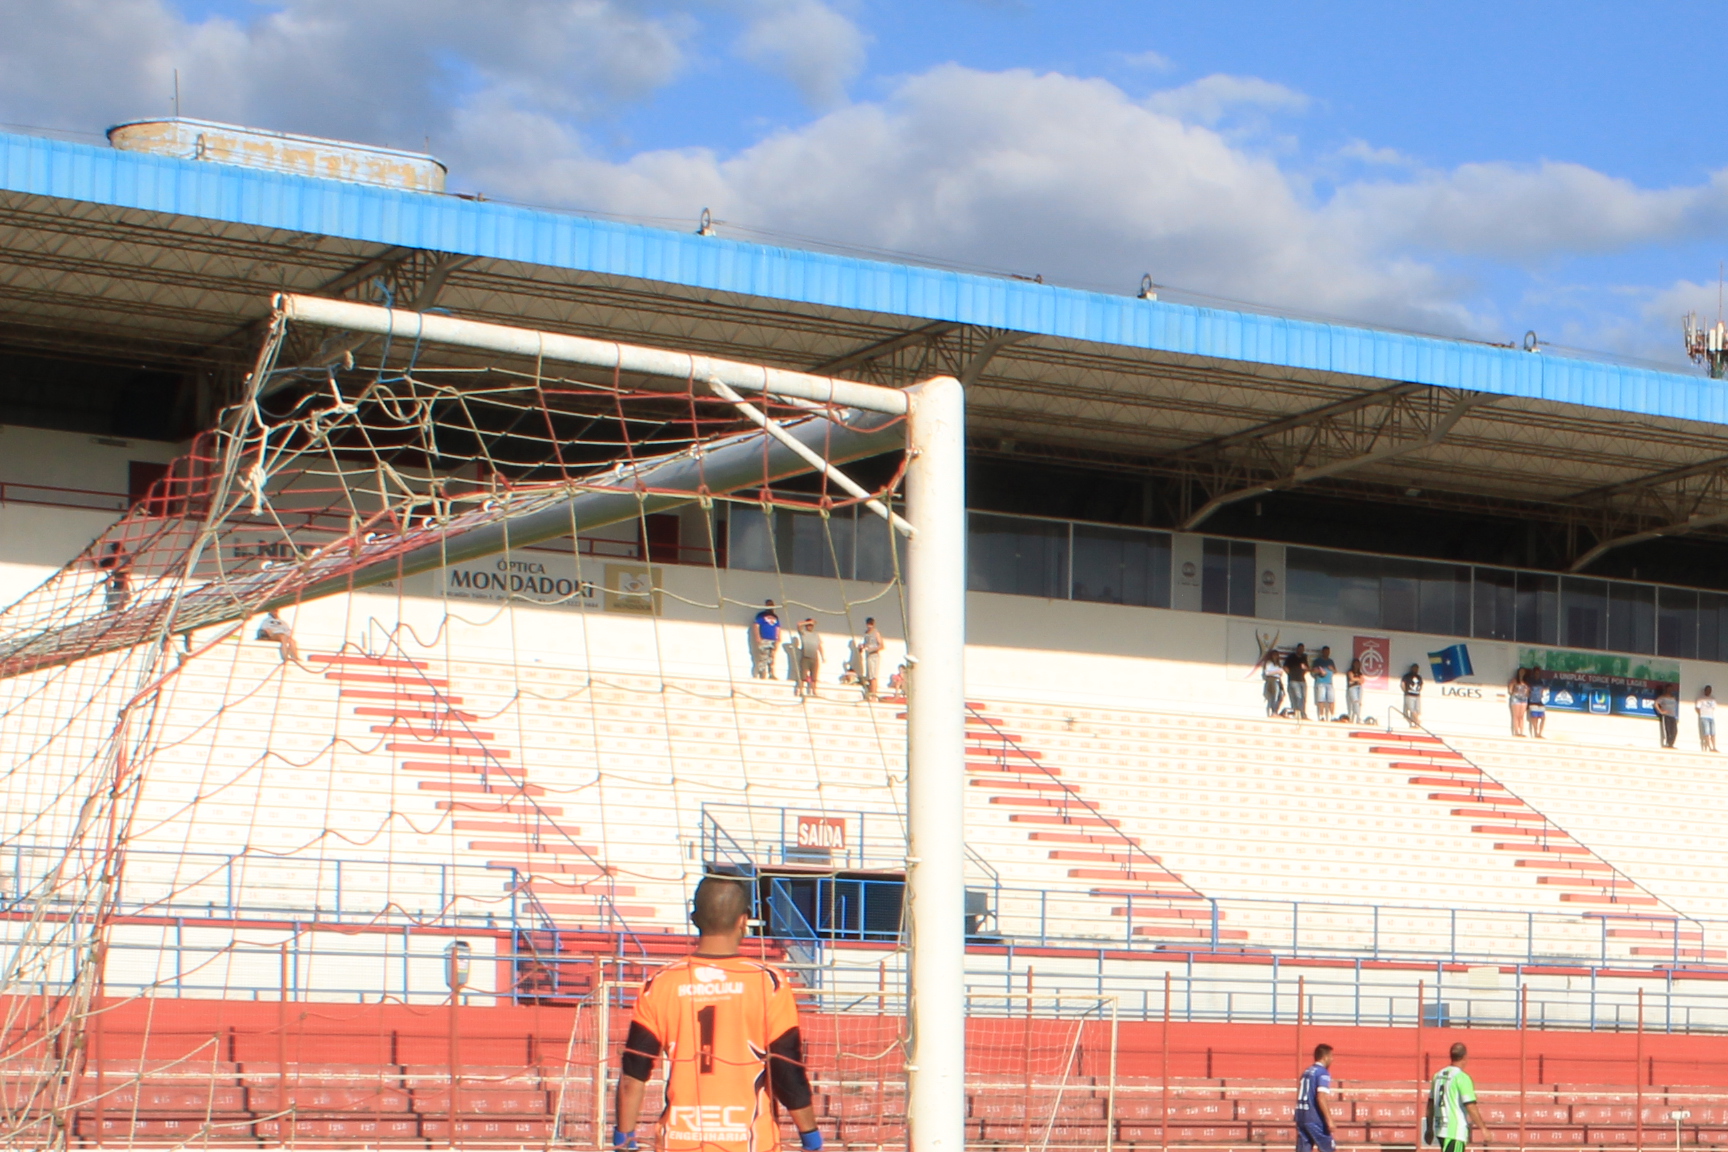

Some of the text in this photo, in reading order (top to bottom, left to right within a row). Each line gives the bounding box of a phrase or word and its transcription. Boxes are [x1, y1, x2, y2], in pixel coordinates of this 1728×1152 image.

[497, 557, 545, 574] ÓPTICA
[451, 570, 594, 598] MONDADORI
[1560, 674, 1586, 682] UNIPLAC
[1589, 676, 1609, 684] TORCE
[1627, 680, 1647, 688] LAGES
[1442, 686, 1482, 699] LAGES
[799, 818, 844, 848] SAÍDA
[698, 1005, 716, 1074] 1
[671, 1106, 747, 1132] REC
[669, 1131, 748, 1142] ENGENHARIA
